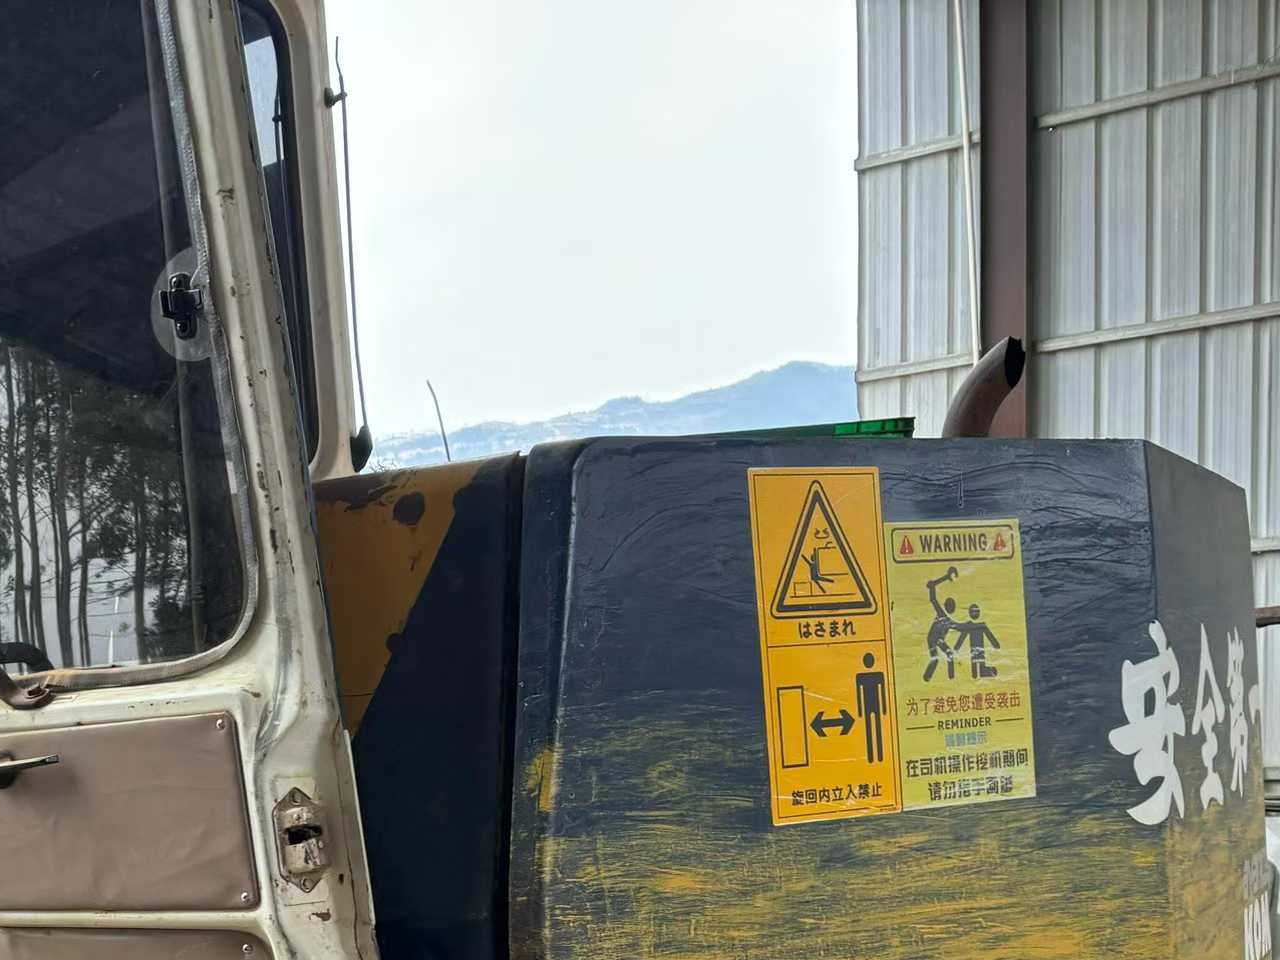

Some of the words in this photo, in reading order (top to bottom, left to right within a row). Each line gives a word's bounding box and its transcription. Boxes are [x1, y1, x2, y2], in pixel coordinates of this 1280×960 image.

[919, 533, 988, 553] WARNING
[798, 619, 856, 639] はさまれ
[906, 688, 1021, 716] 为了避免您遭受袭击
[937, 716, 992, 731] REMINDER
[906, 748, 1029, 778] 在司机操作挖机期间
[791, 783, 883, 806] 旋回内立入禁止
